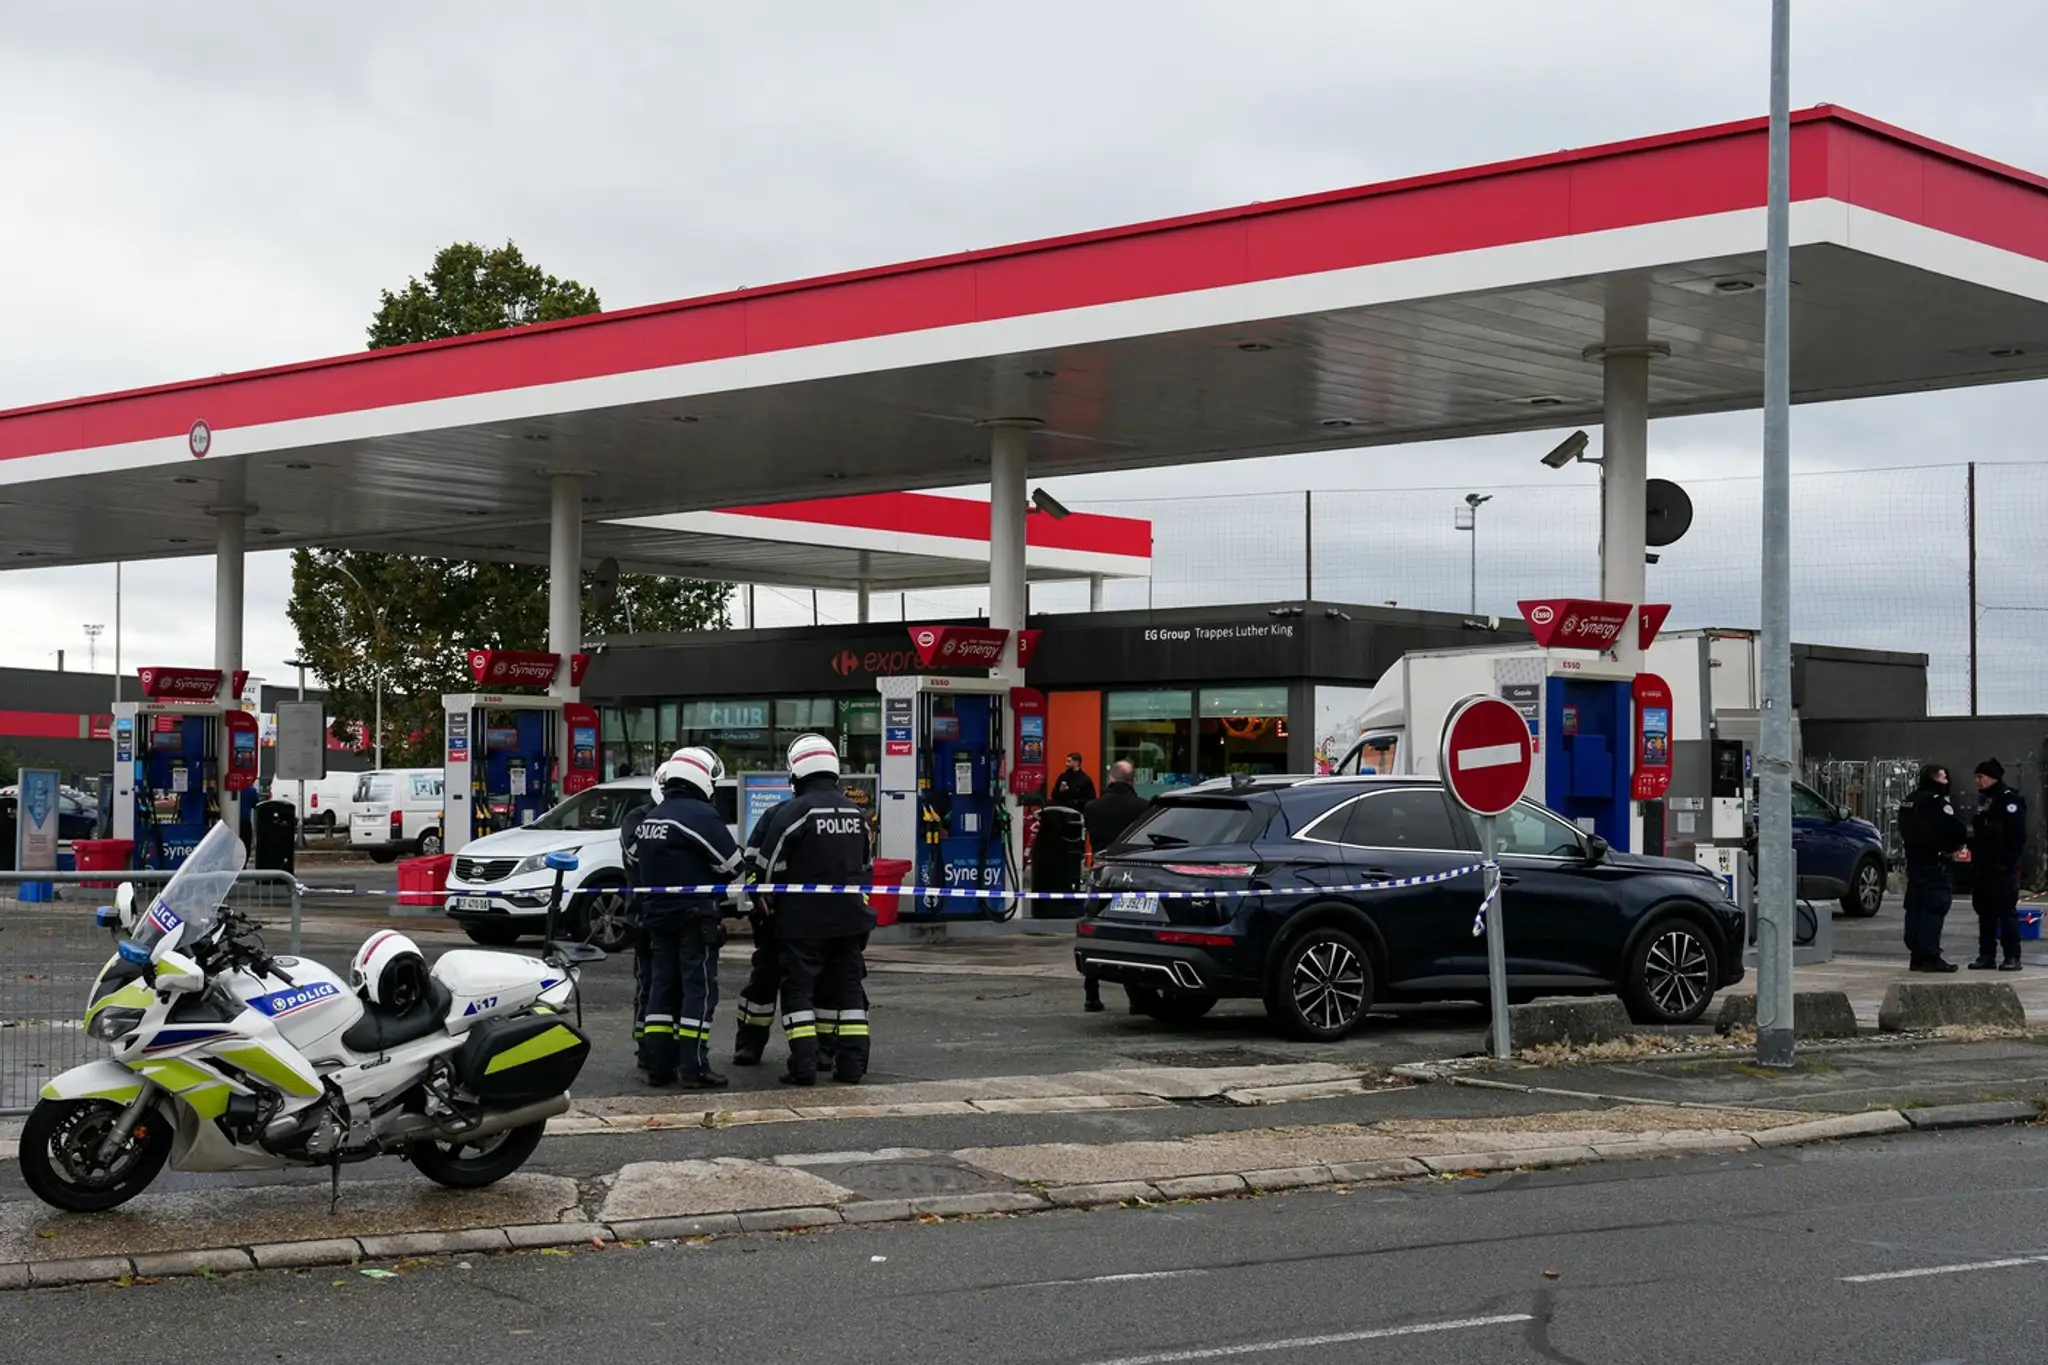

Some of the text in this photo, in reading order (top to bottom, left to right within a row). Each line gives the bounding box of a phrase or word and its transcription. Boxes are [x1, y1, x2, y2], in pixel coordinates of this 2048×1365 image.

[1576, 618, 1620, 639] Synergy
[1642, 615, 1650, 629] 1
[1145, 624, 1293, 642] EG Group Trappes Luther King
[957, 640, 999, 659] Synergy
[1020, 639, 1027, 650] 3
[509, 664, 551, 678] Synergy
[864, 651, 924, 676] expre
[1562, 660, 1581, 670] ESSO
[174, 679, 216, 692] Synergy
[710, 707, 763, 726] CLUB
[816, 818, 861, 835] POLICE
[944, 863, 1001, 886] Synegy
[153, 902, 177, 929] LICE
[286, 984, 334, 1007] POLICE
